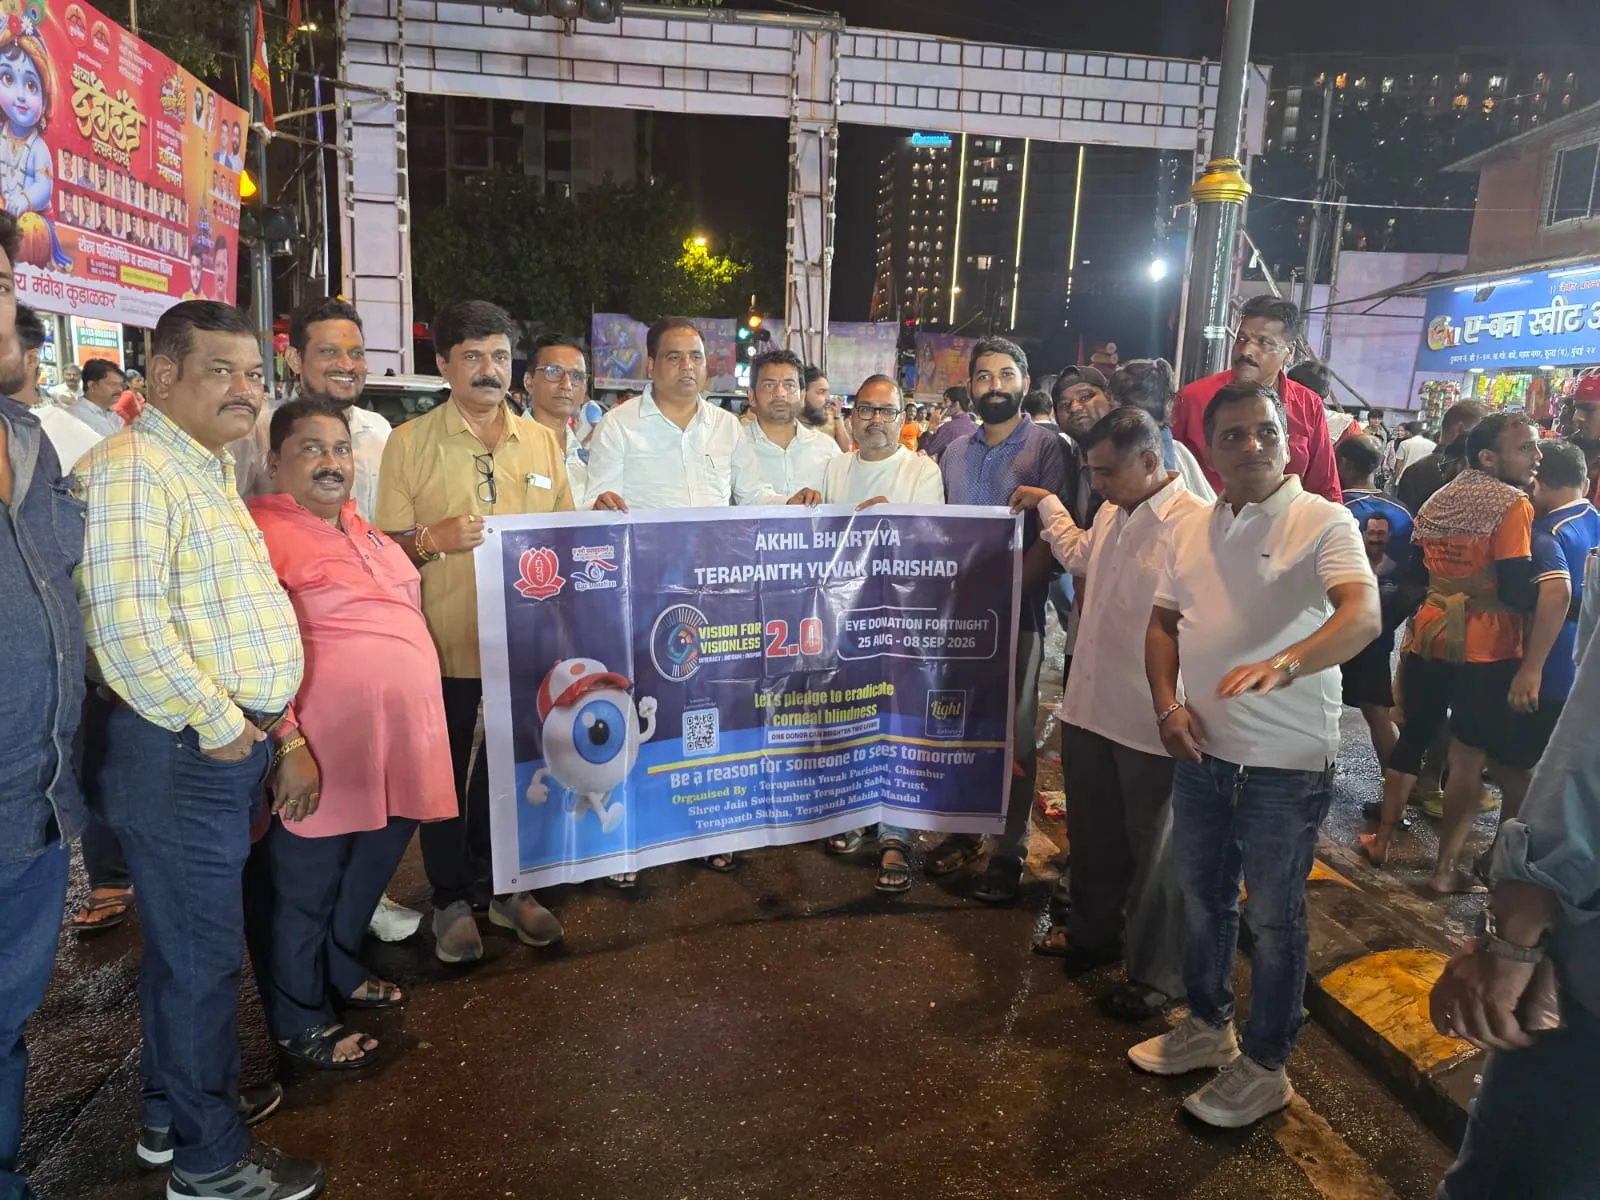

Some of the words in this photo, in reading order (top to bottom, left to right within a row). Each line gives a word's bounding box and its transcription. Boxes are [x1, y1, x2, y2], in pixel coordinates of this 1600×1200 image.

[31, 272, 64, 299] मंगेश
[66, 283, 116, 308] कुडाळकर
[1528, 295, 1588, 336] स्वीट
[755, 533, 808, 550] AKHIL
[813, 530, 900, 548] BHARTIYA
[694, 563, 802, 585] TERAPANTH
[807, 560, 868, 579] YUVAK
[872, 559, 958, 577] PARISHAD
[699, 625, 737, 639] VISION
[741, 622, 762, 635] FOR
[845, 619, 866, 631] EYE
[868, 617, 922, 630] DONATION
[925, 619, 989, 631] FORTNIGHT
[700, 637, 760, 654] VISIONLESS
[766, 618, 823, 657] 2.0
[858, 637, 871, 648] 25
[873, 633, 893, 646] AUG
[903, 636, 920, 648] 08
[923, 636, 945, 648] SEP
[947, 636, 976, 648] 2026
[754, 692, 782, 708] Let's
[784, 690, 828, 708] pledge
[830, 689, 842, 703] to
[844, 681, 894, 702] eradicate
[773, 709, 822, 727] corneal
[824, 704, 878, 724] blindness
[931, 700, 961, 720] Light
[785, 731, 808, 740] DONOR
[809, 730, 822, 738] CAN
[670, 772, 689, 789] Be
[694, 771, 702, 785] a
[707, 764, 758, 782] reason
[760, 758, 782, 774] for
[786, 751, 850, 772] someone
[853, 748, 866, 762] to
[869, 744, 897, 758] sees
[901, 746, 976, 765] tomorrow
[672, 787, 730, 805] Organised
[733, 786, 747, 796] By
[759, 776, 816, 791] Terapanth
[818, 770, 847, 783] Yuvak
[850, 763, 892, 778] Parishad,
[895, 765, 946, 780] Chembur
[688, 805, 721, 817] Shree
[723, 801, 748, 811] Jain
[751, 792, 811, 805] Swetamber
[813, 781, 862, 798] Terapanth
[864, 776, 891, 789] Sabha
[894, 778, 928, 792] Trust,
[696, 813, 752, 829] Terapanth
[795, 796, 845, 817] Terapanth
[848, 791, 879, 805] Mahila
[881, 789, 920, 803] Mandal
